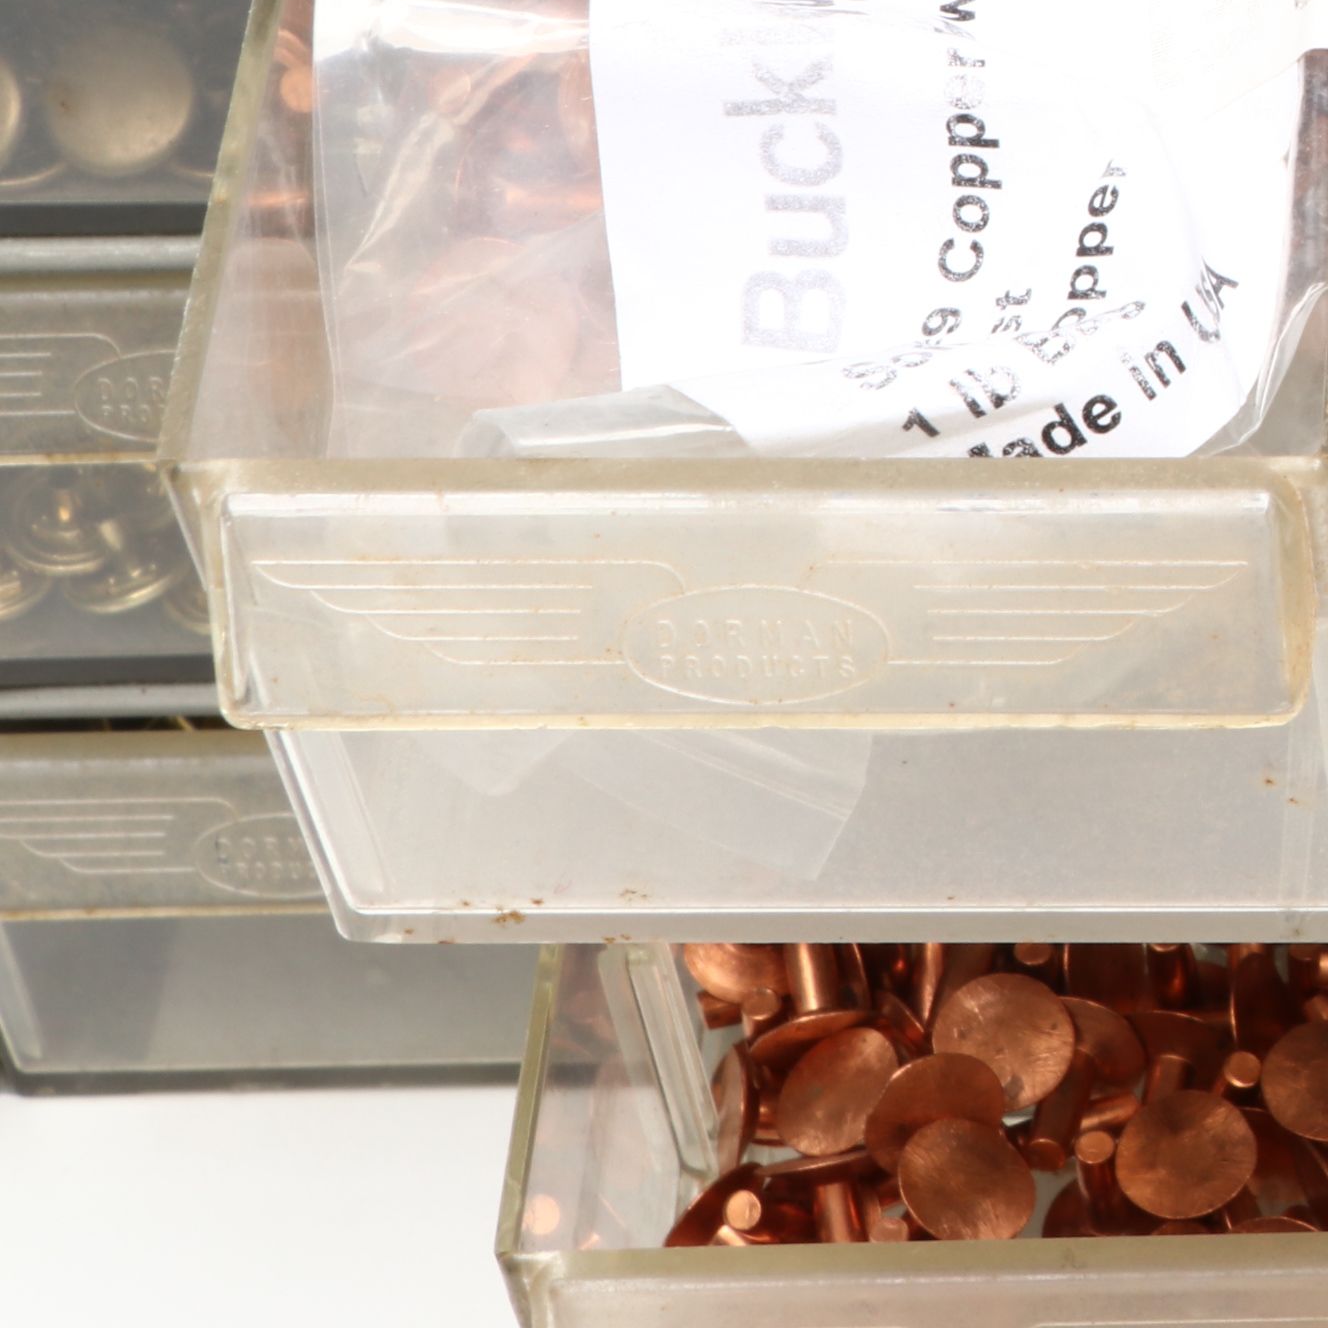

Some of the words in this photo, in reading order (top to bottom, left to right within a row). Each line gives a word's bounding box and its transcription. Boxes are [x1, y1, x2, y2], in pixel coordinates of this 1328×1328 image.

[938, 47, 1003, 283] Copper
[1119, 338, 1187, 402] in
[655, 619, 854, 650] DORMAN
[658, 654, 856, 679] PRODUCTS
